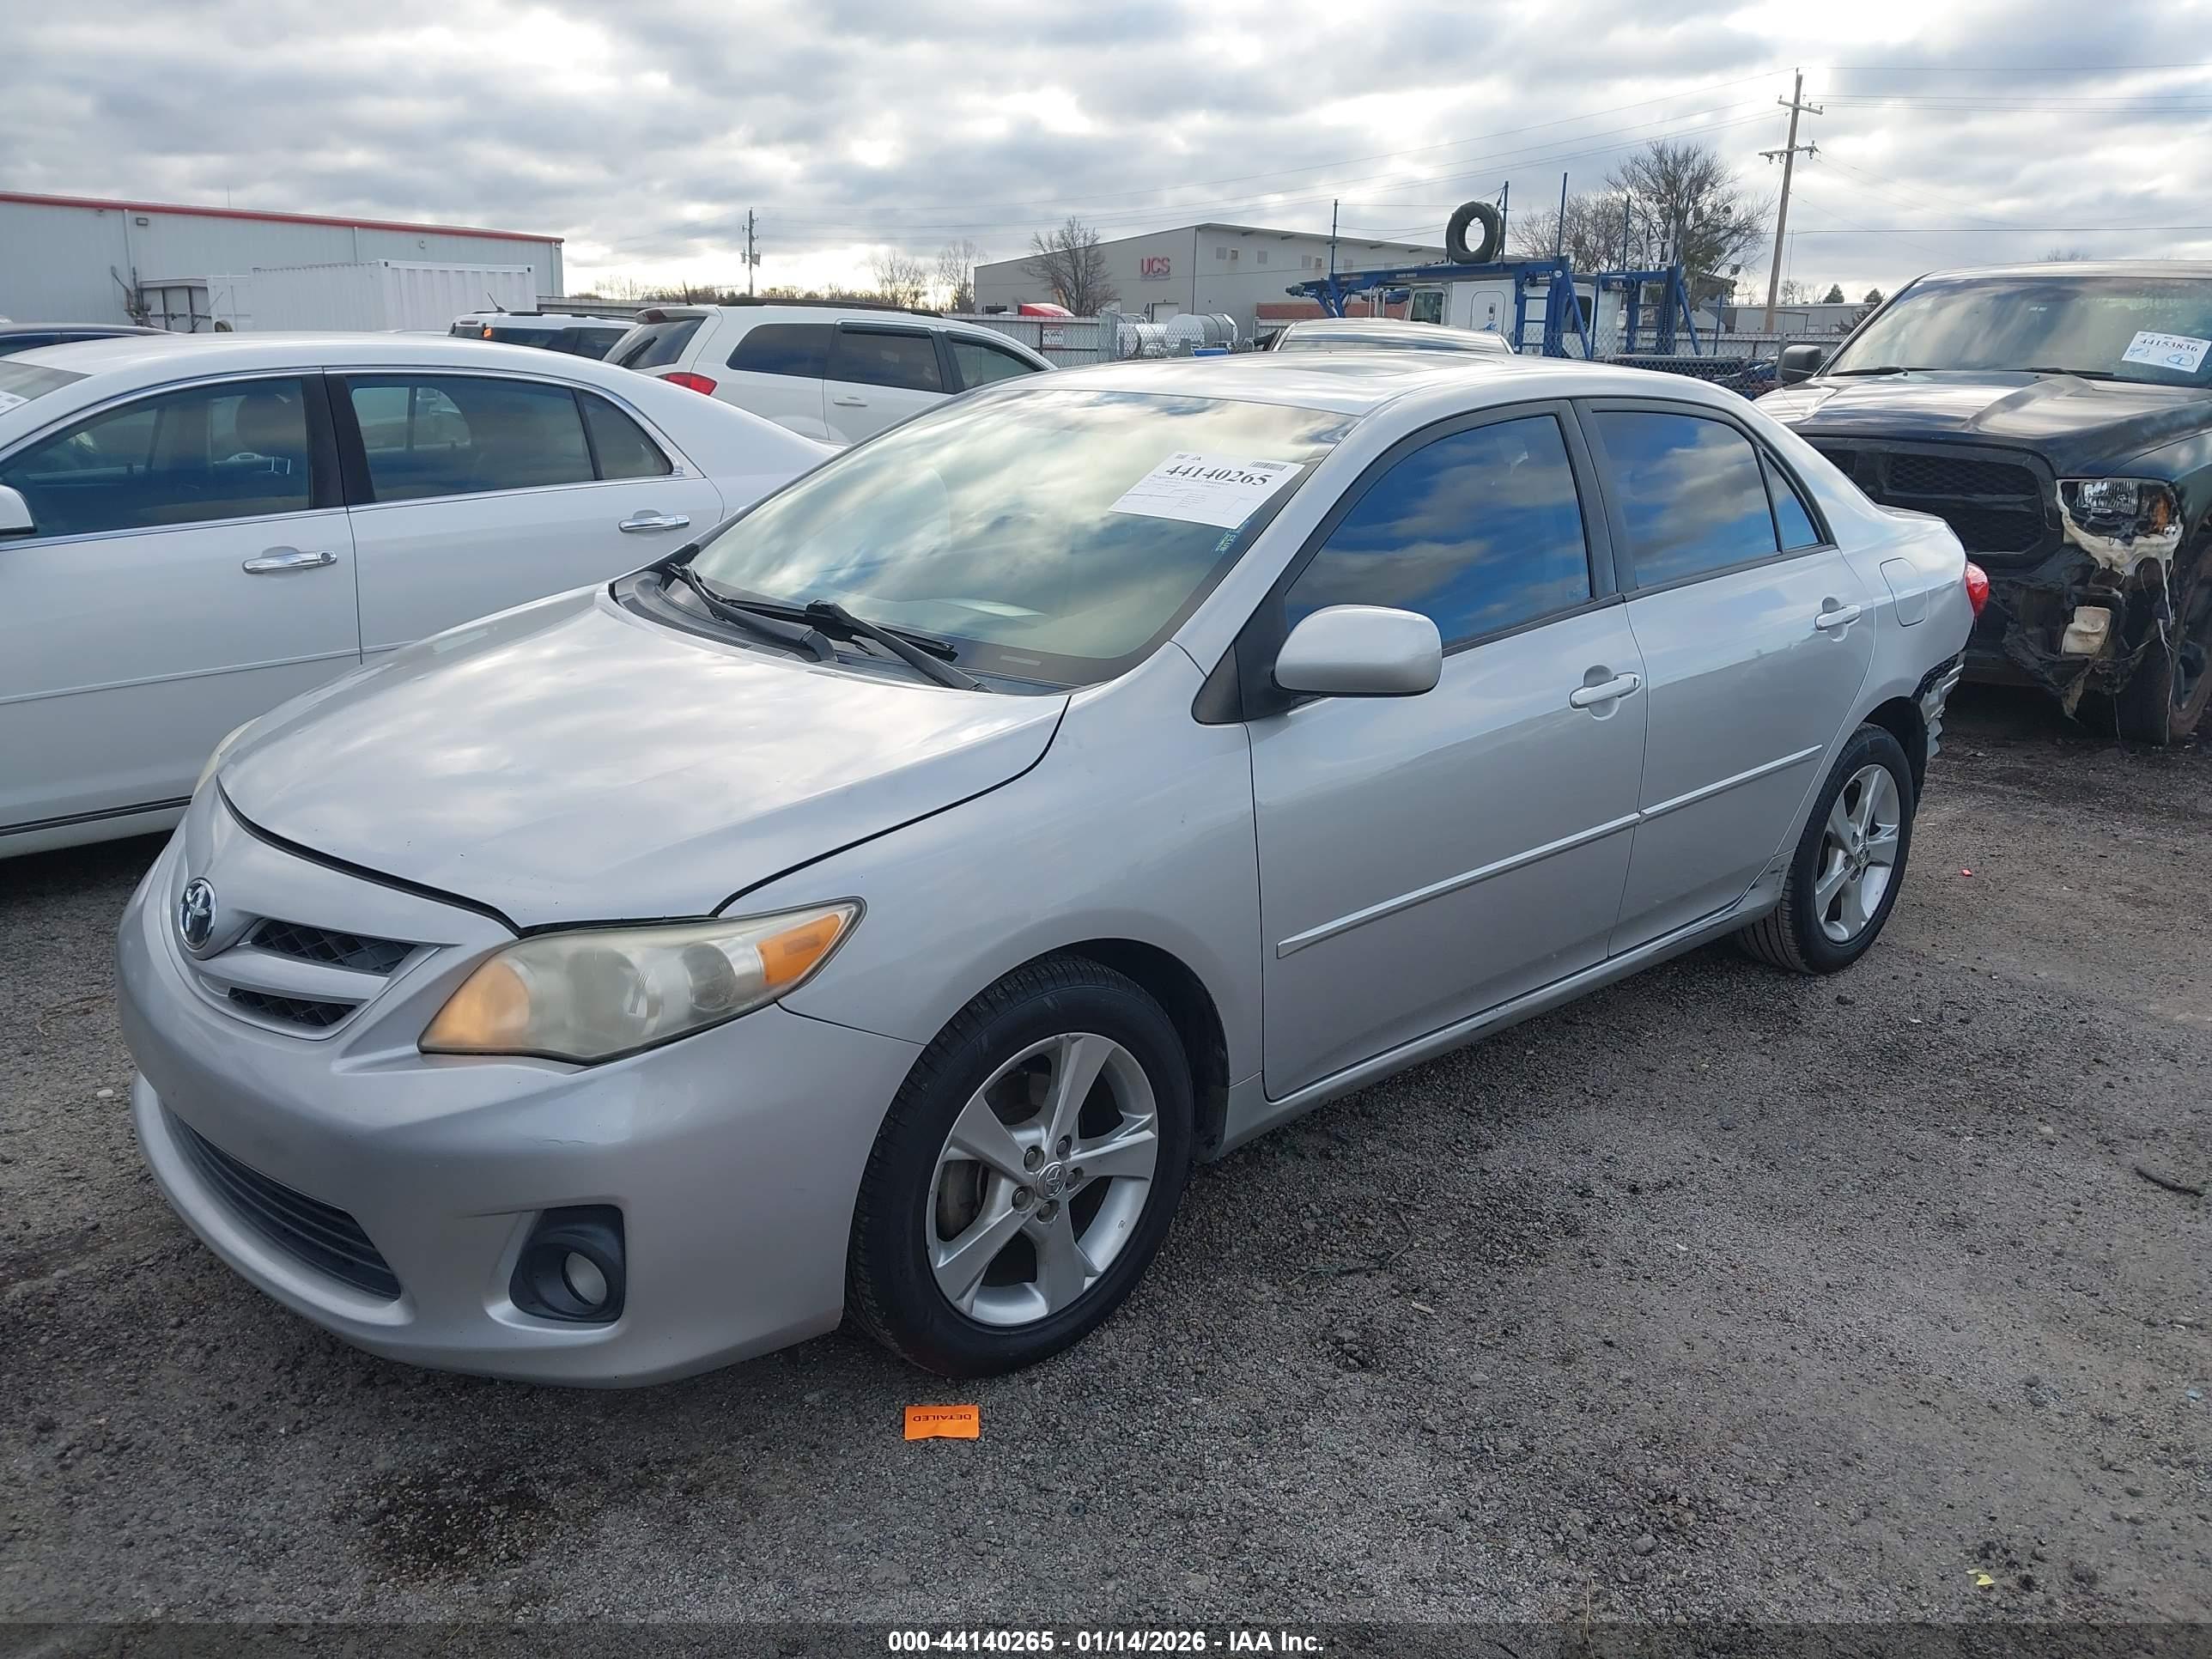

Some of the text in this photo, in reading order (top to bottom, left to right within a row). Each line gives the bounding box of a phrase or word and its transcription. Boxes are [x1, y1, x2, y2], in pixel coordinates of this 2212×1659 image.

[1141, 257, 1170, 275] UCS
[2140, 338, 2198, 352] 44153836
[1165, 464, 1273, 486] 44140265
[913, 1413, 972, 1422] DETAILED
